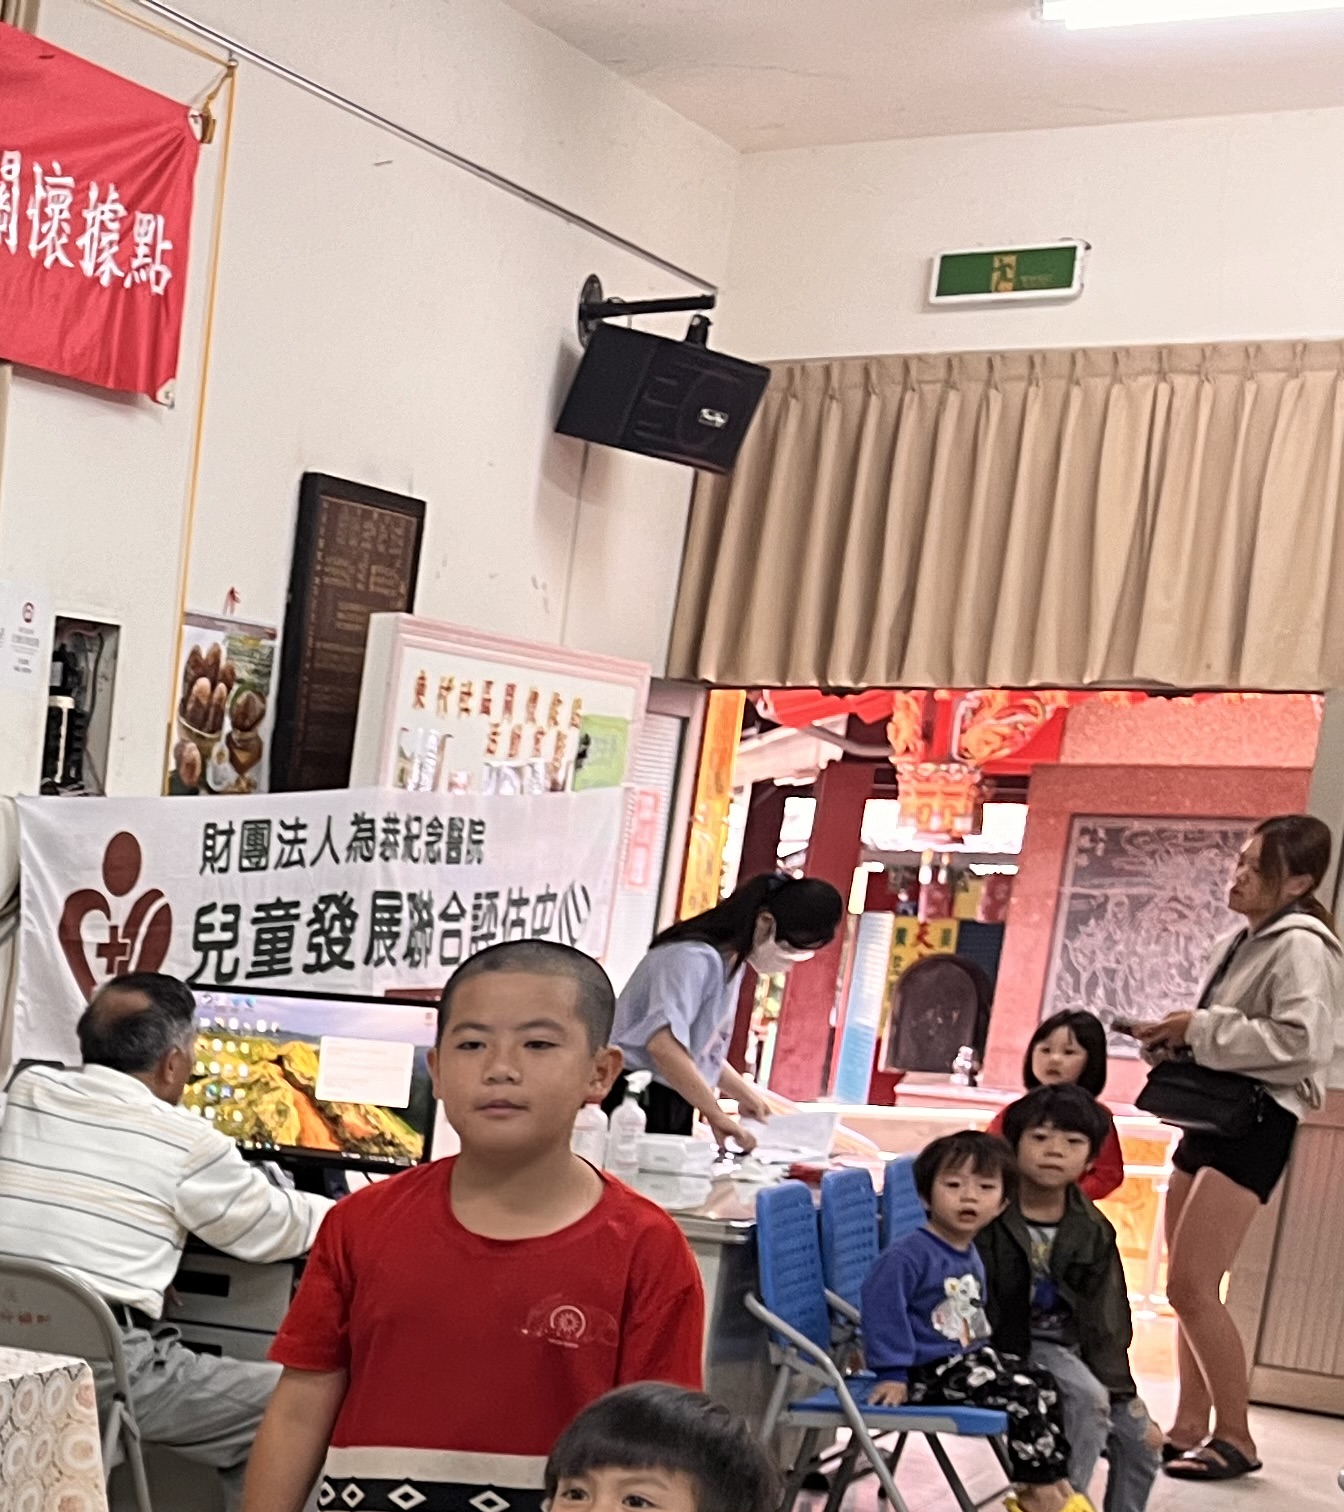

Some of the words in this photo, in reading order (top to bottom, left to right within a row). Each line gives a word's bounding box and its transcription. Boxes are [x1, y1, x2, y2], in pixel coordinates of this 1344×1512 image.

[186, 880, 592, 985] 兒童發展聯合評估中心
